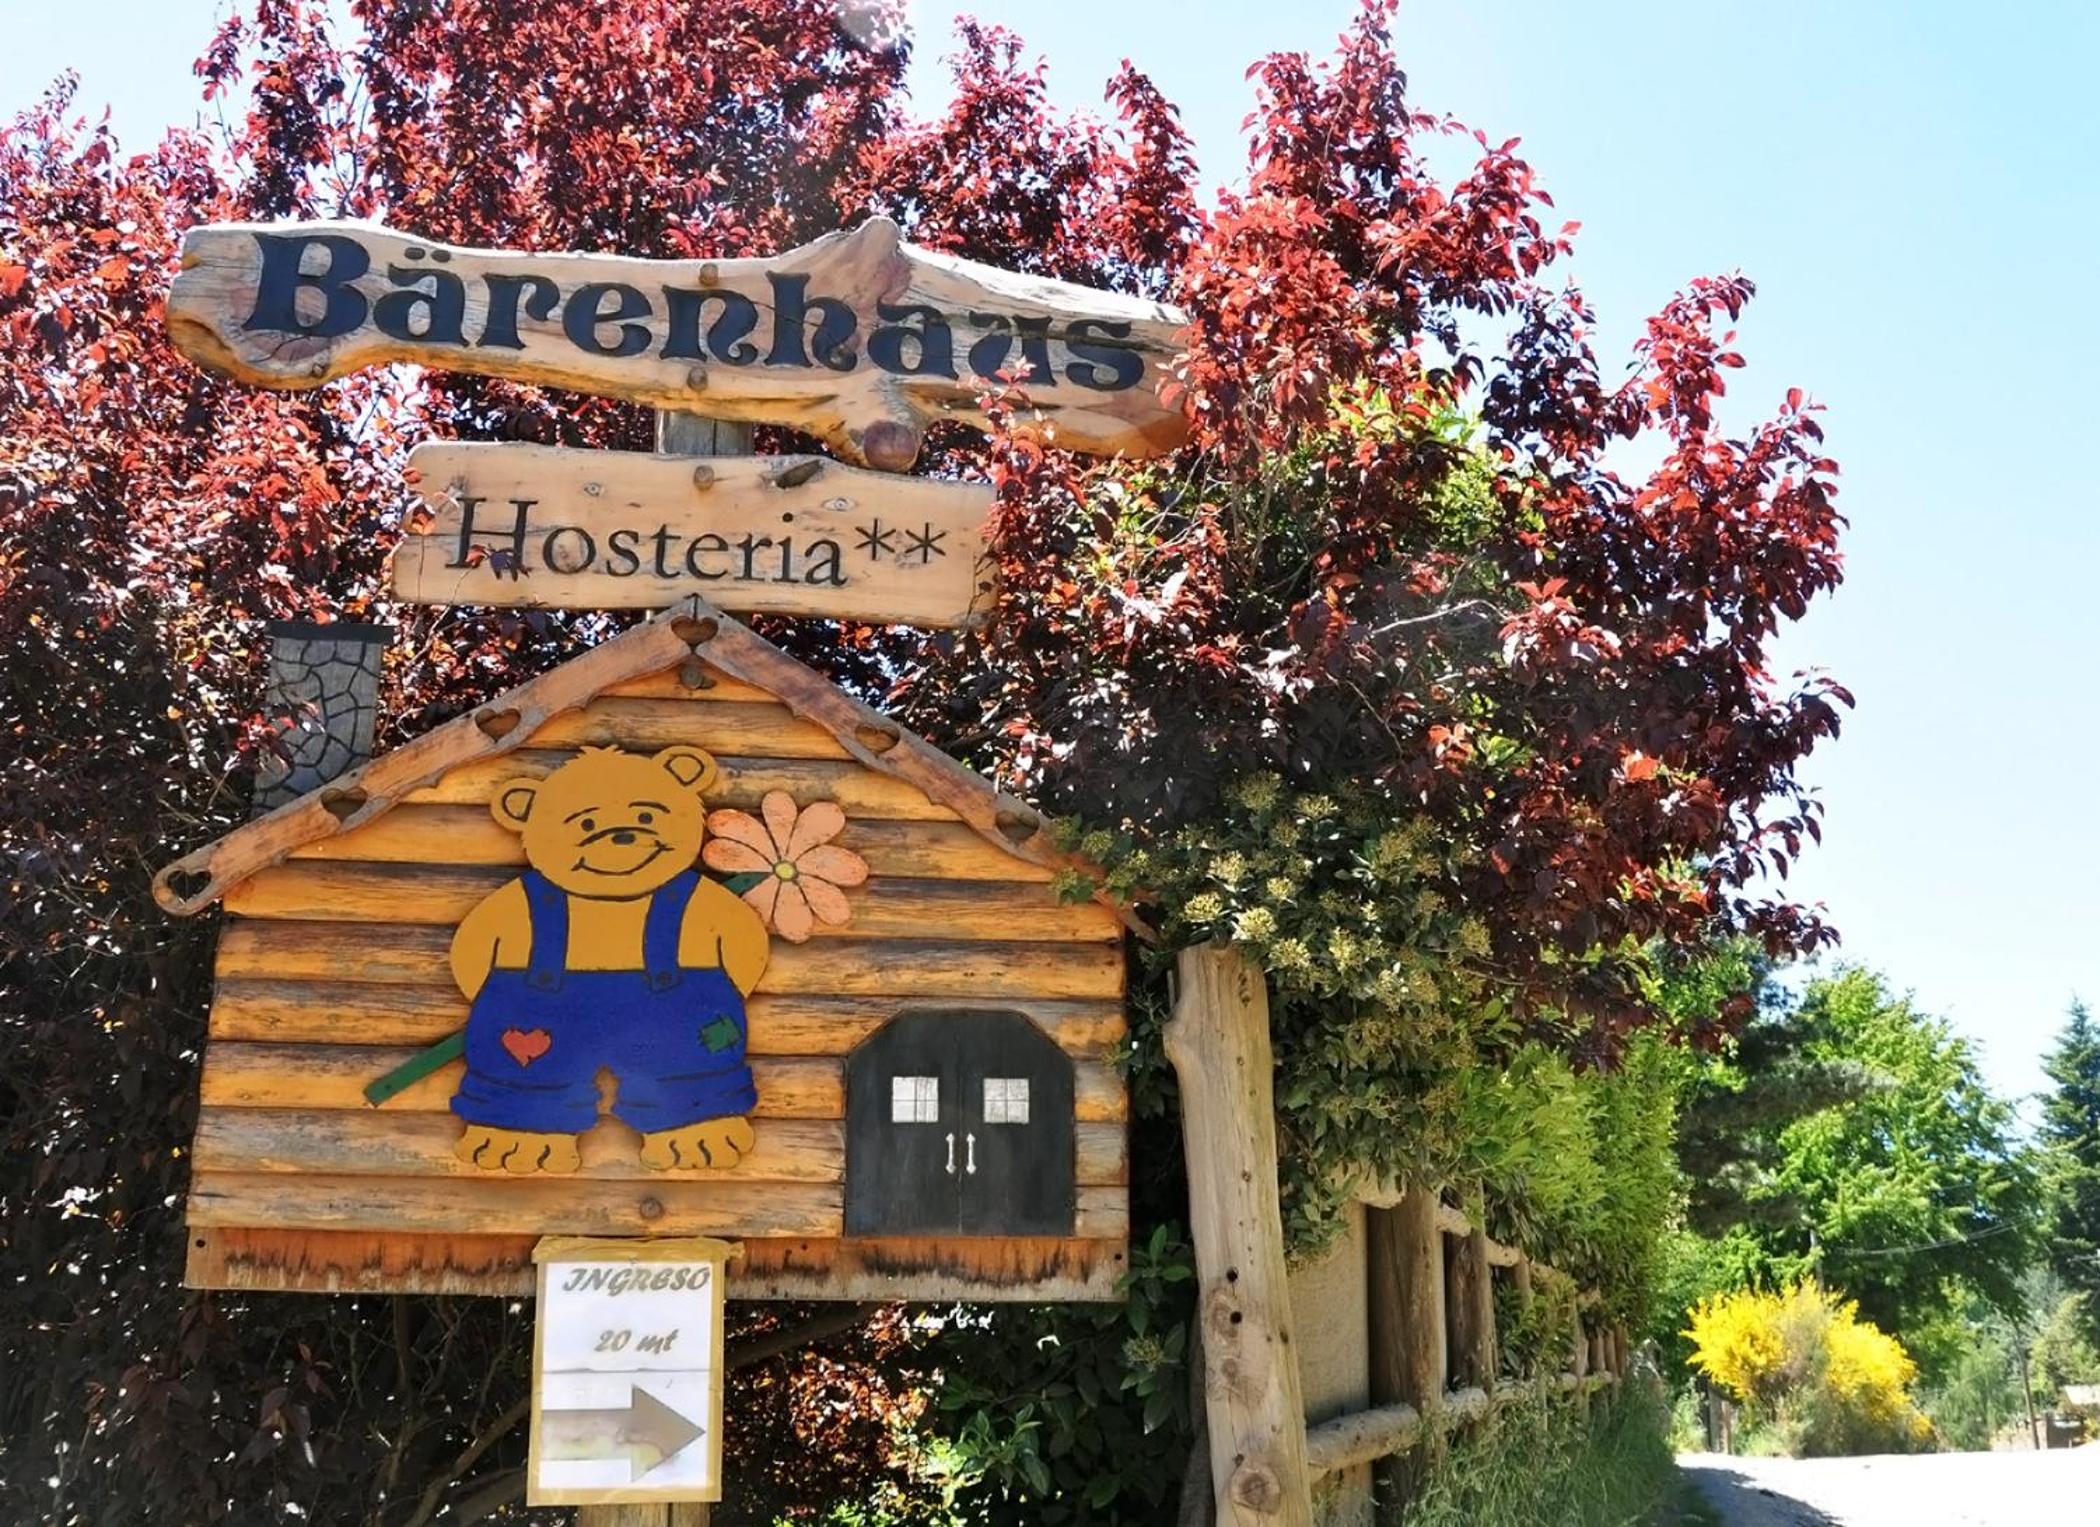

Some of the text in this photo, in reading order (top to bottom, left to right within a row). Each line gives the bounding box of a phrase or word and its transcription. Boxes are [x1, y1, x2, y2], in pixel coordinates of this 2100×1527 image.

[242, 233, 1144, 391] Bärenhaus
[563, 1267, 711, 1297] INGRESO
[594, 1329, 679, 1355] 20 mt
